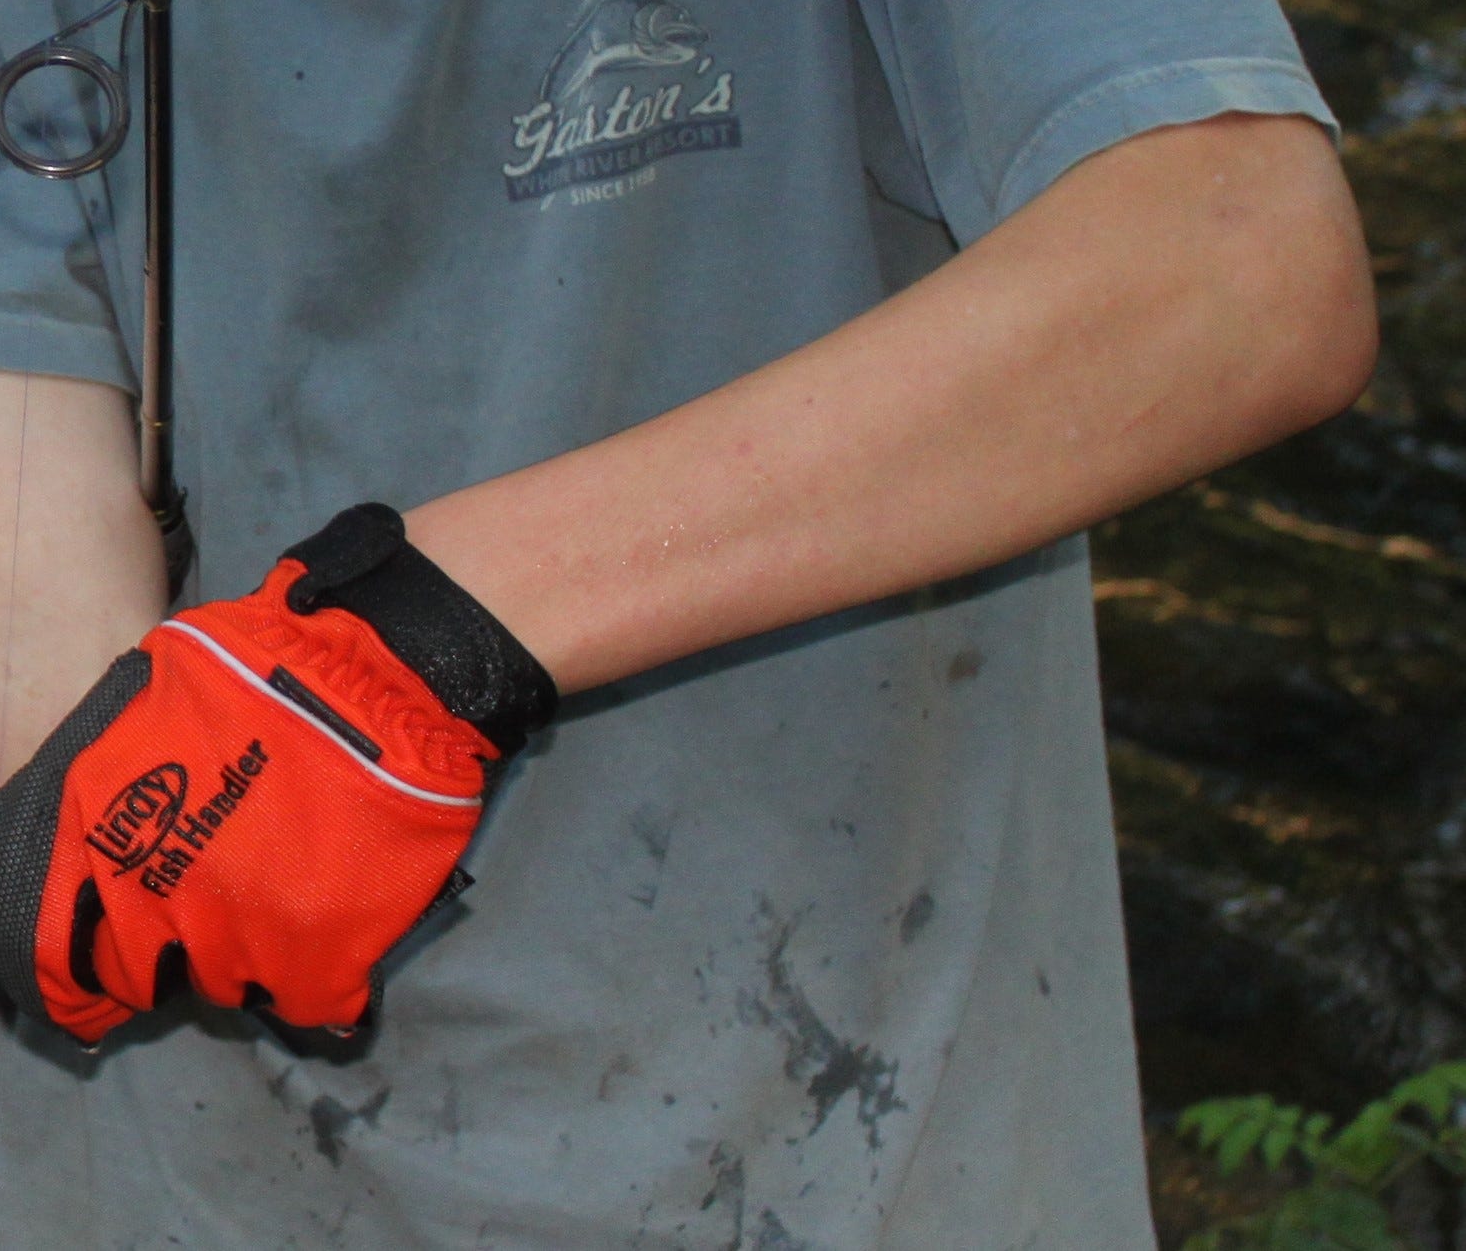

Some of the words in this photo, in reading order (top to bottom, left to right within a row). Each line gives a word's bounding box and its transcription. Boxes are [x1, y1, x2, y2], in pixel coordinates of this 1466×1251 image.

[503, 57, 733, 177] Gaston's
[85, 769, 184, 871] Lindy
[139, 846, 195, 899] Fish
[173, 738, 269, 850] Handler
